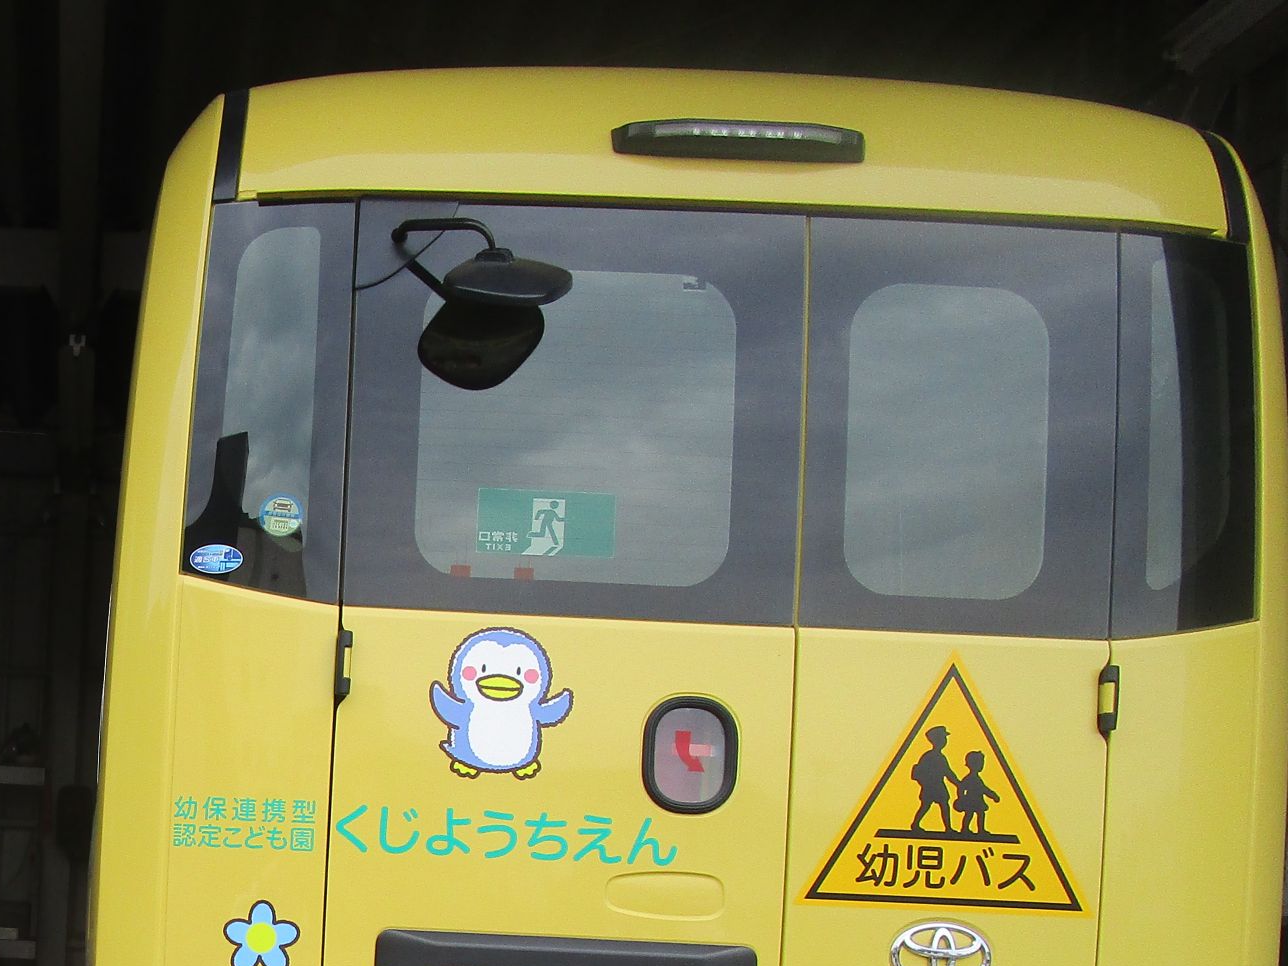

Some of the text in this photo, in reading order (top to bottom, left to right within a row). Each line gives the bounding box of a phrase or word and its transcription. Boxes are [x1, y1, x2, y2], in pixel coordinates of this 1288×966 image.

[173, 795, 317, 825] 幼保連携型
[172, 823, 316, 852] 認定こども園
[335, 804, 678, 867] くじようちえん
[855, 843, 1036, 892] 幼児バス
